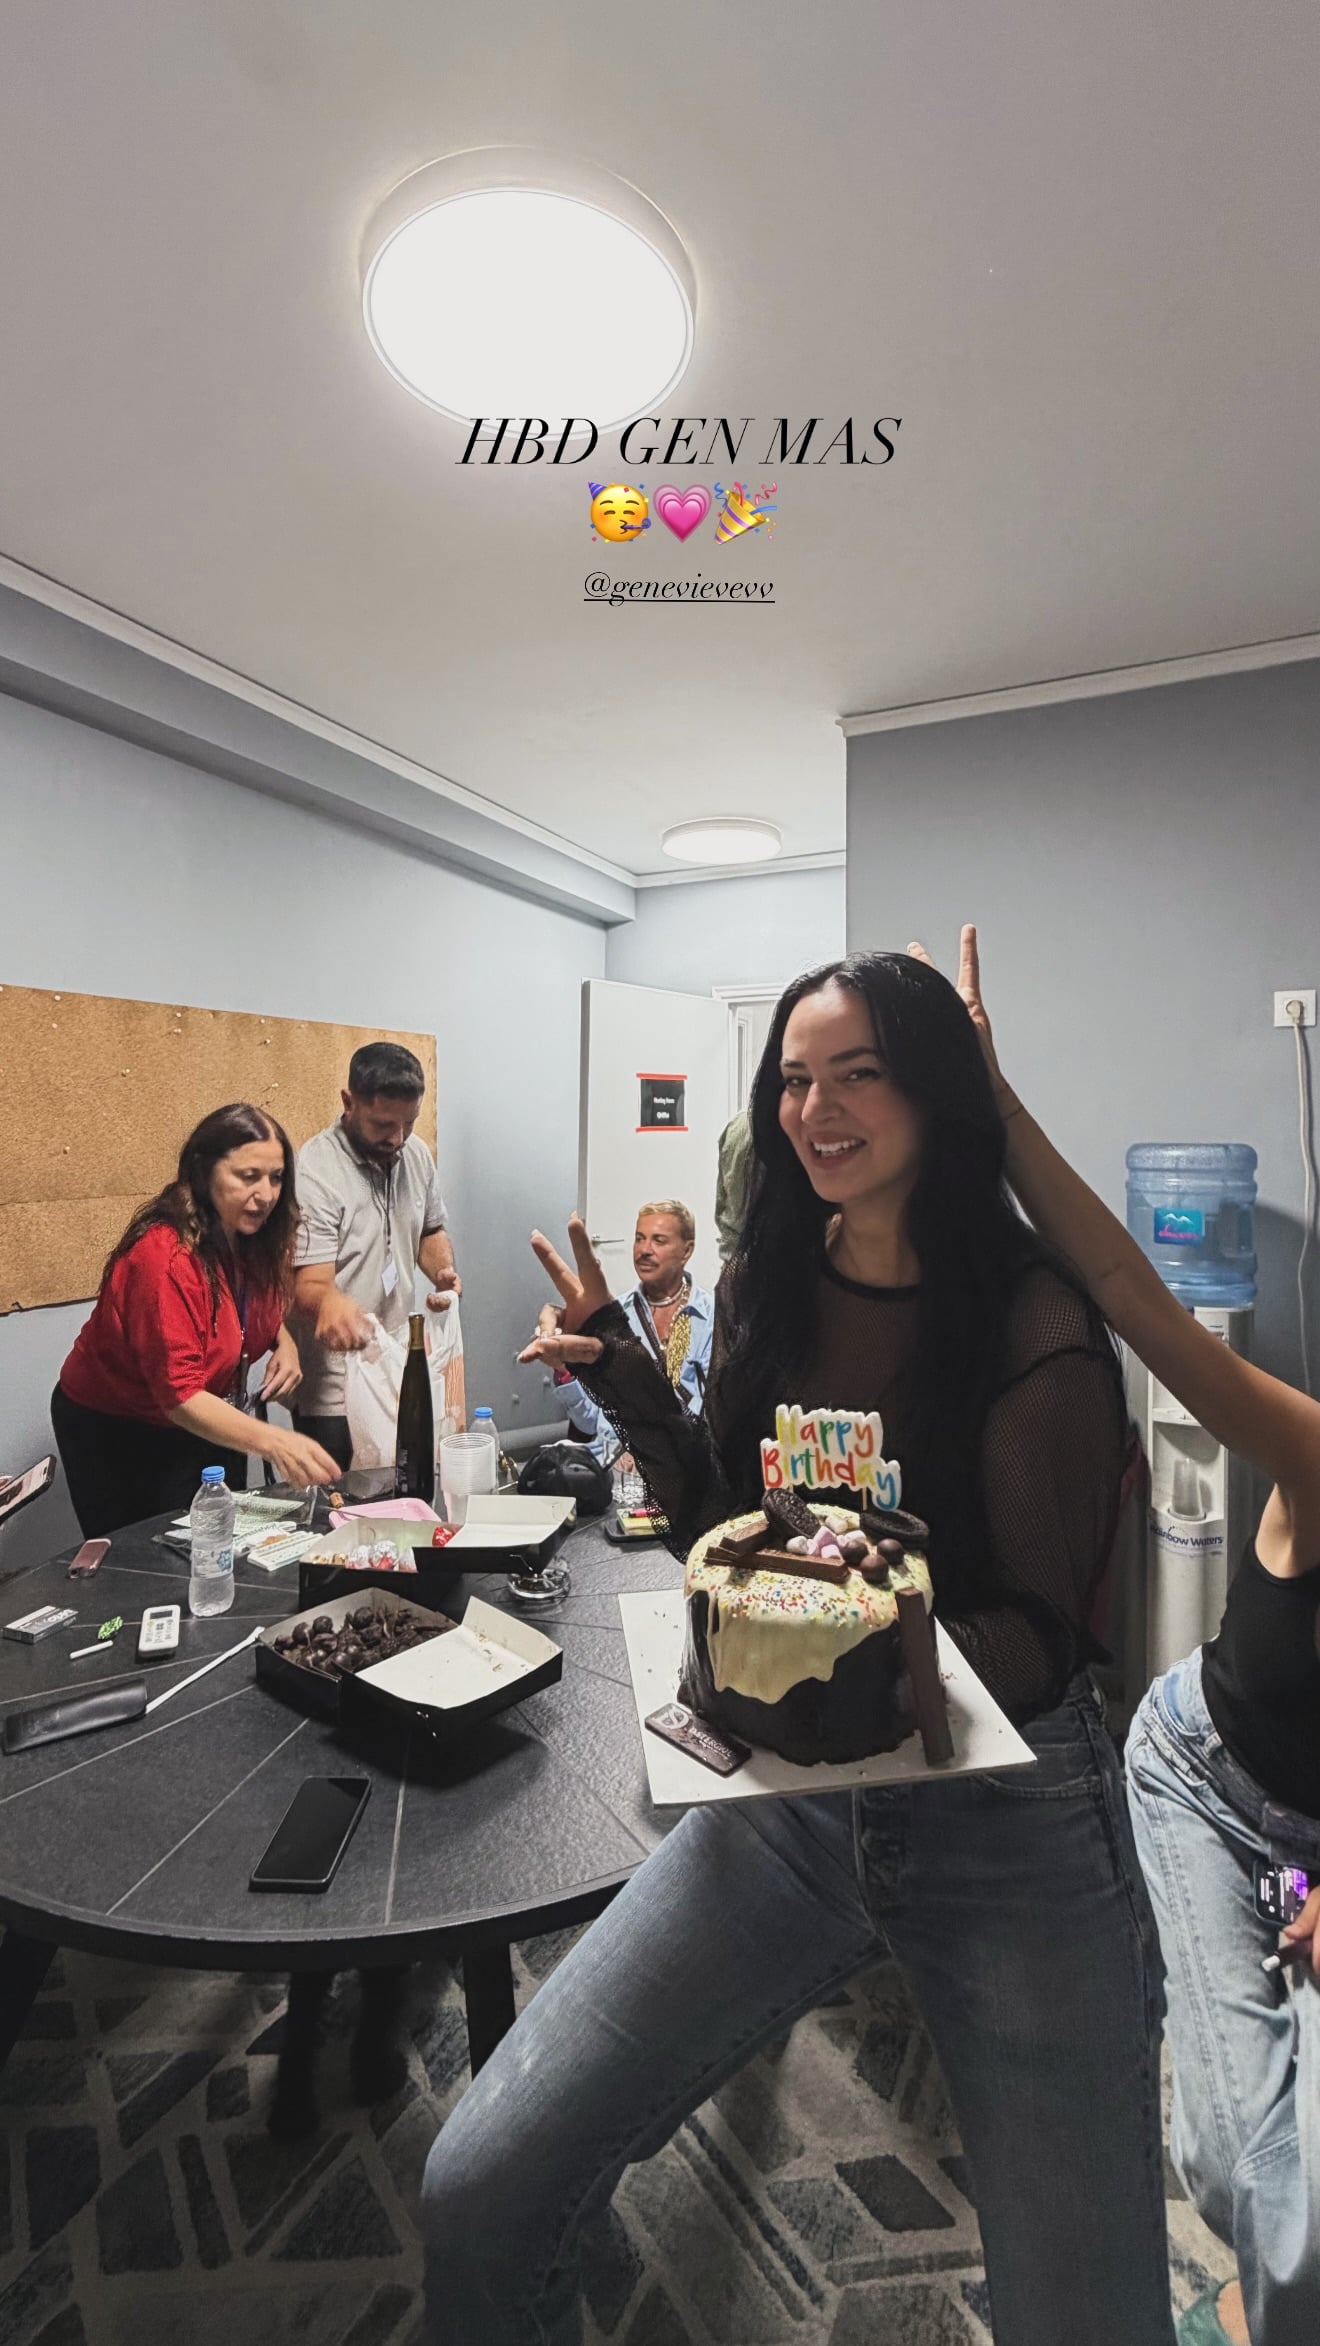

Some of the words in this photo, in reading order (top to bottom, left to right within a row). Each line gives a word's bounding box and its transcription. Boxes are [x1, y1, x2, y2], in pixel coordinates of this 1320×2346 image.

[776, 1412, 874, 1458] Happy
[763, 1447, 896, 1511] Birthday
[1150, 1525, 1189, 1546] Rainbow
[1190, 1536, 1223, 1547] Waters
